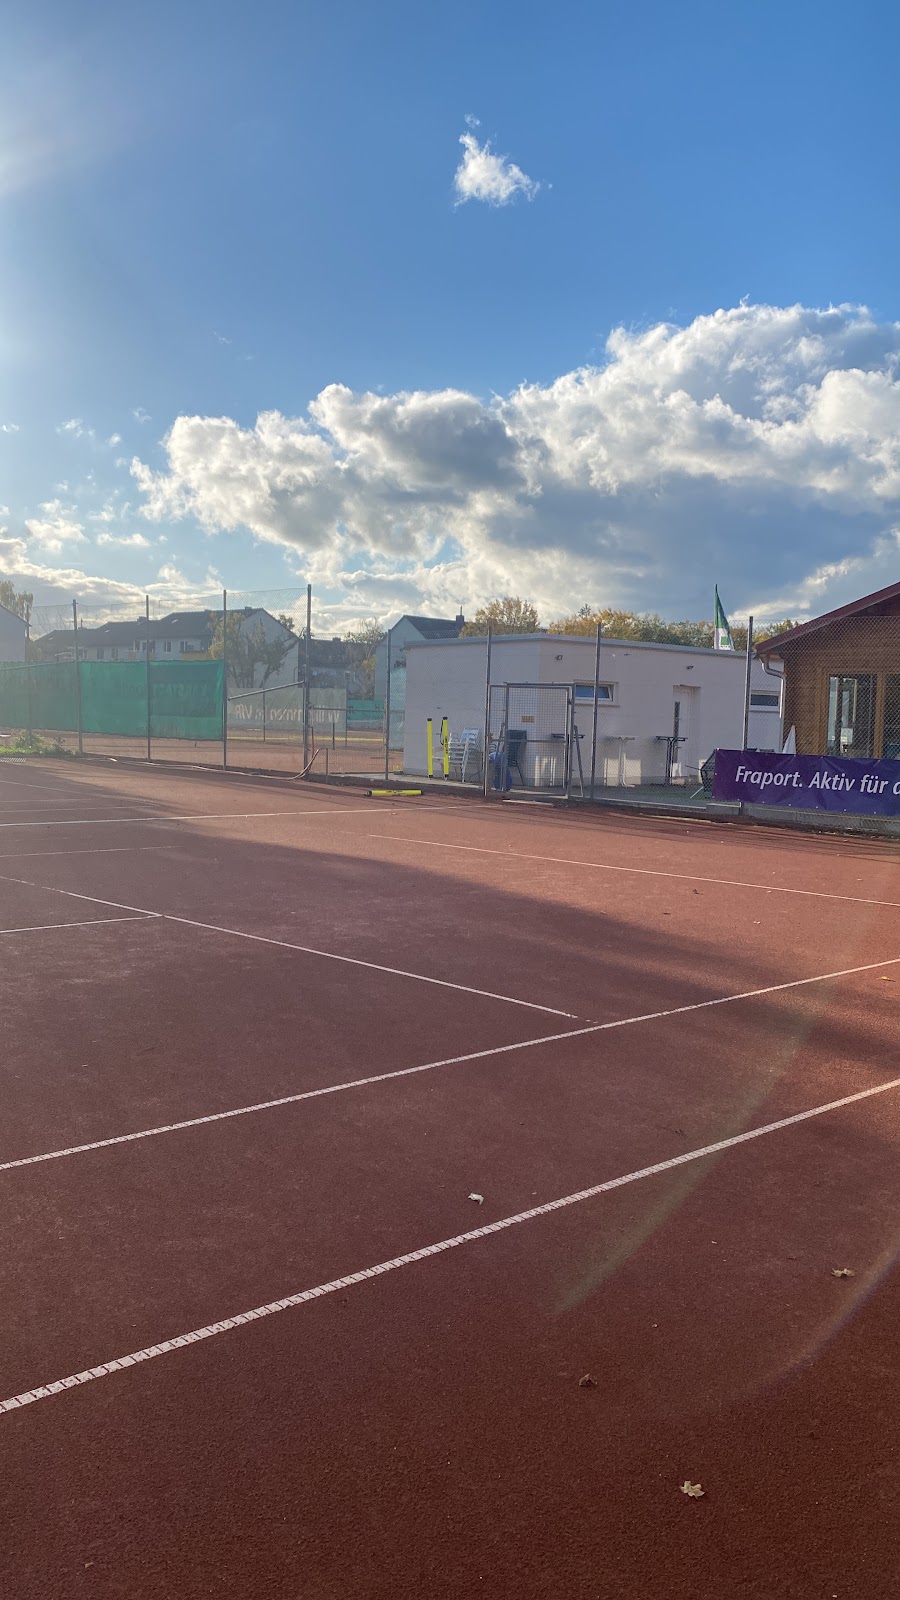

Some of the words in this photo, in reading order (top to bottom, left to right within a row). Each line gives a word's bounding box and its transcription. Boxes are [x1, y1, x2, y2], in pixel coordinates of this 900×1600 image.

[735, 765, 803, 790] Fraport.
[808, 771, 855, 792] Aktiv
[860, 774, 889, 794] für
